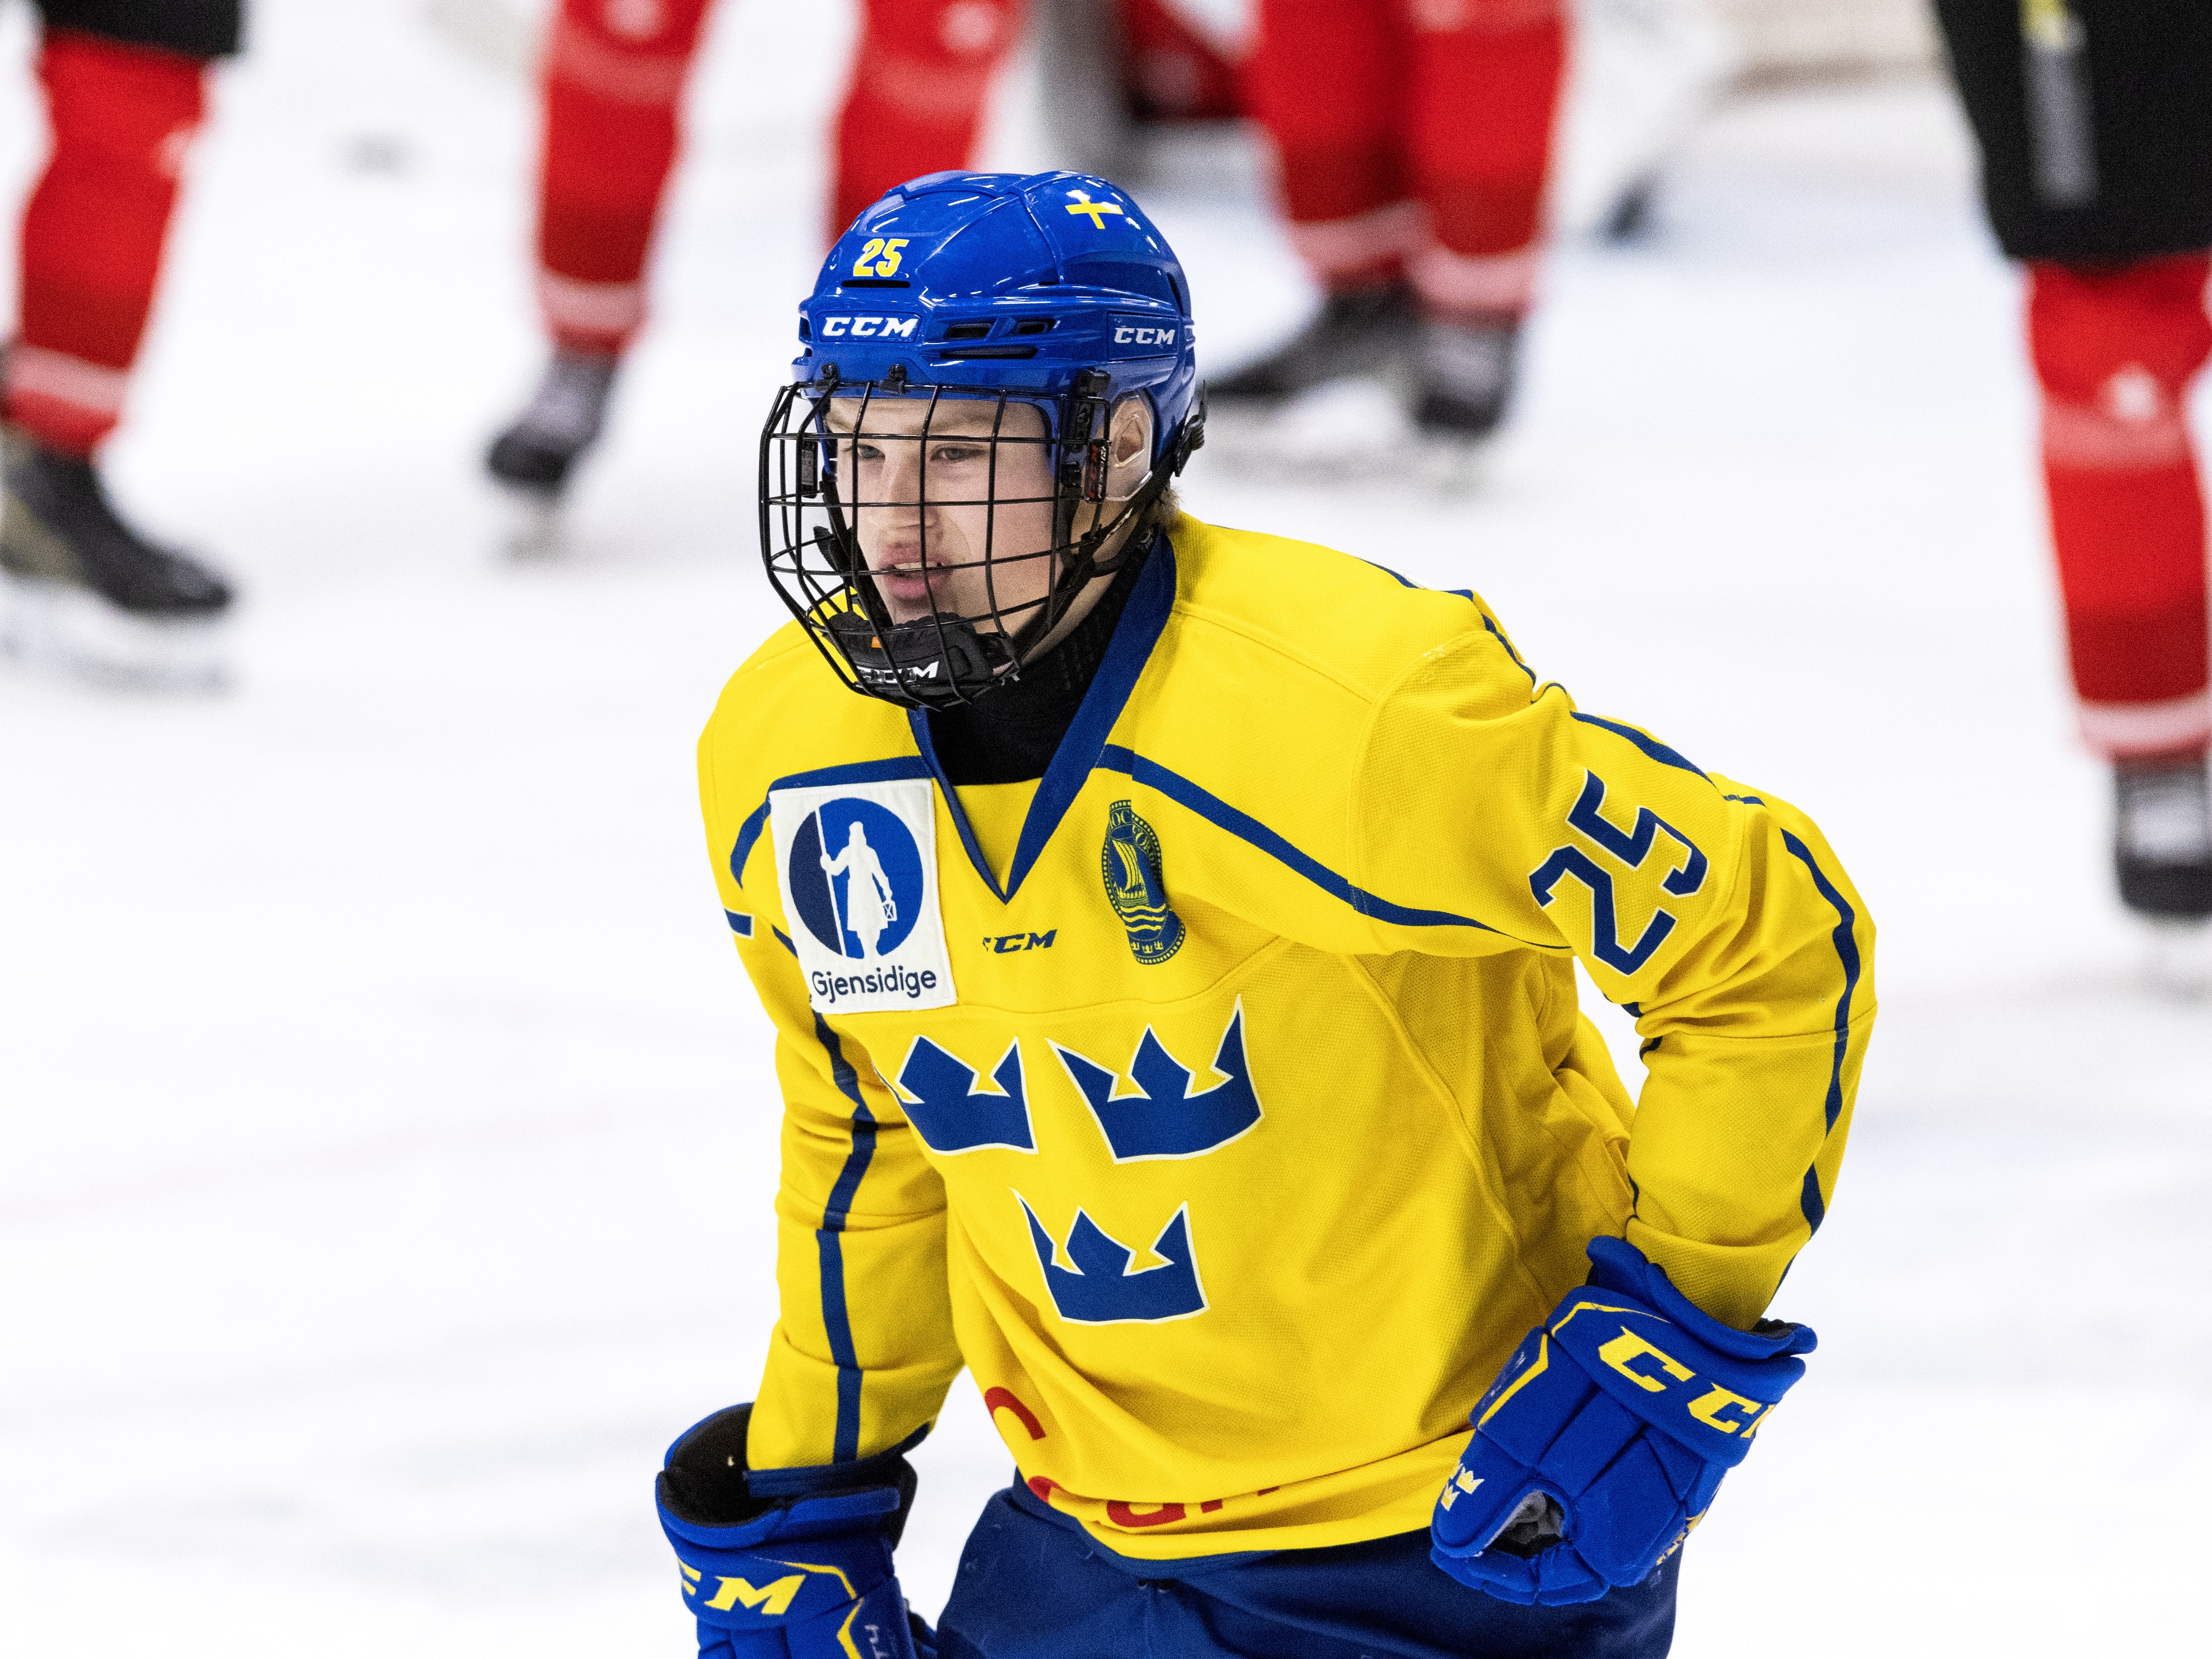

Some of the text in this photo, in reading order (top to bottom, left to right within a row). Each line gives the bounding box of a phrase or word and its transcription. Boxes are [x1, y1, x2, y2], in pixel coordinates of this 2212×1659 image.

[854, 239, 908, 277] 25
[822, 317, 919, 338] CCM
[1114, 327, 1175, 345] CCM
[1528, 768, 1710, 977] 25
[812, 965, 937, 1003] Gjensidige
